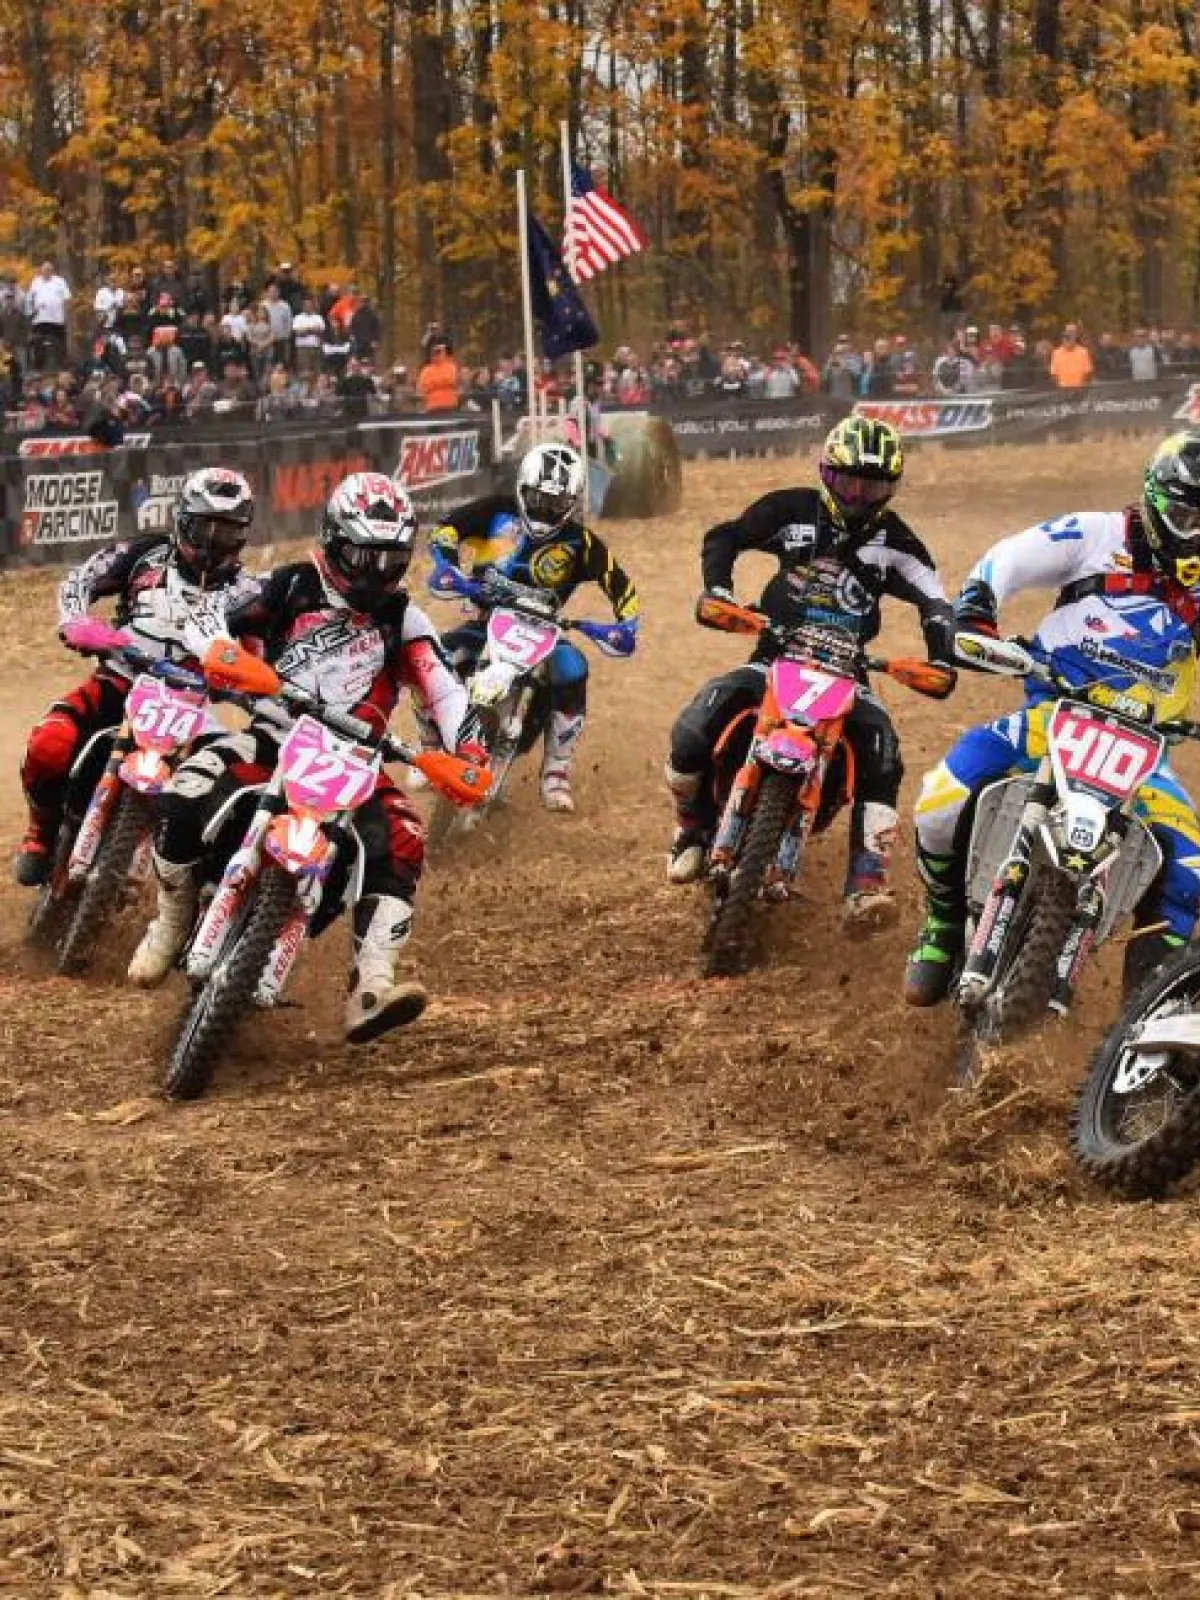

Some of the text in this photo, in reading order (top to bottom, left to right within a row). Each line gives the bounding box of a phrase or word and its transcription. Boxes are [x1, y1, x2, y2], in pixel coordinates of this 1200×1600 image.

[402, 434, 478, 486] AMSOIL
[28, 475, 101, 508] MOOSE
[789, 668, 838, 712] 7
[132, 698, 199, 744] 514
[283, 747, 376, 806] 127
[1055, 720, 1148, 791] 410
